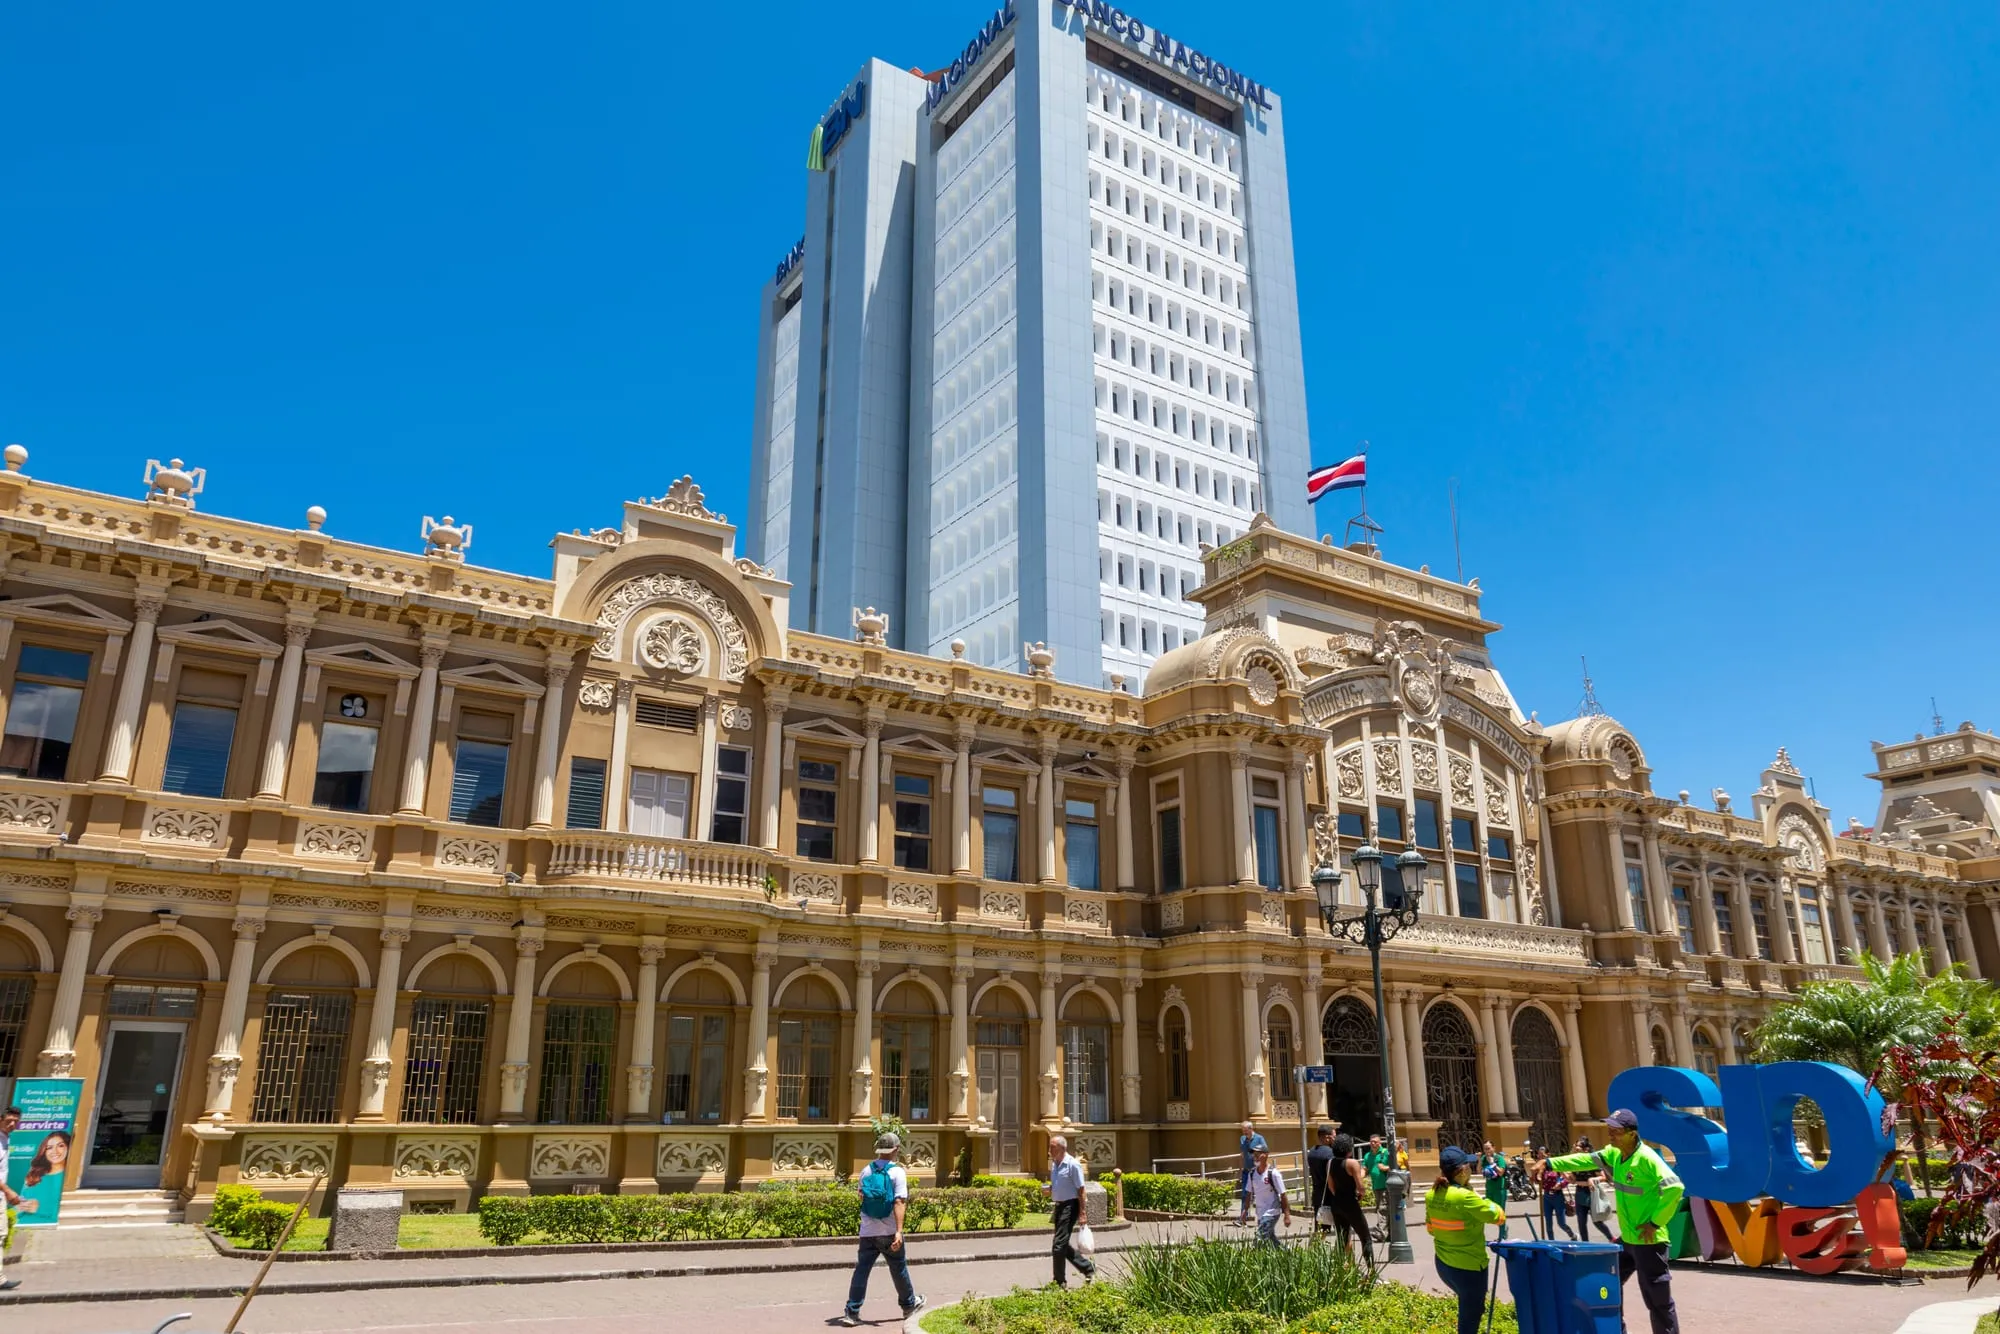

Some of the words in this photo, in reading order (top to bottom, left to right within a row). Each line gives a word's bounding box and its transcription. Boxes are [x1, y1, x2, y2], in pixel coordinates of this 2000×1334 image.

[925, 0, 1016, 117] NACIONAL
[1059, 0, 1145, 43] ANCO
[1153, 28, 1273, 111] NACIONAL
[823, 80, 865, 157] BN
[19, 1120, 65, 1130] servirte
